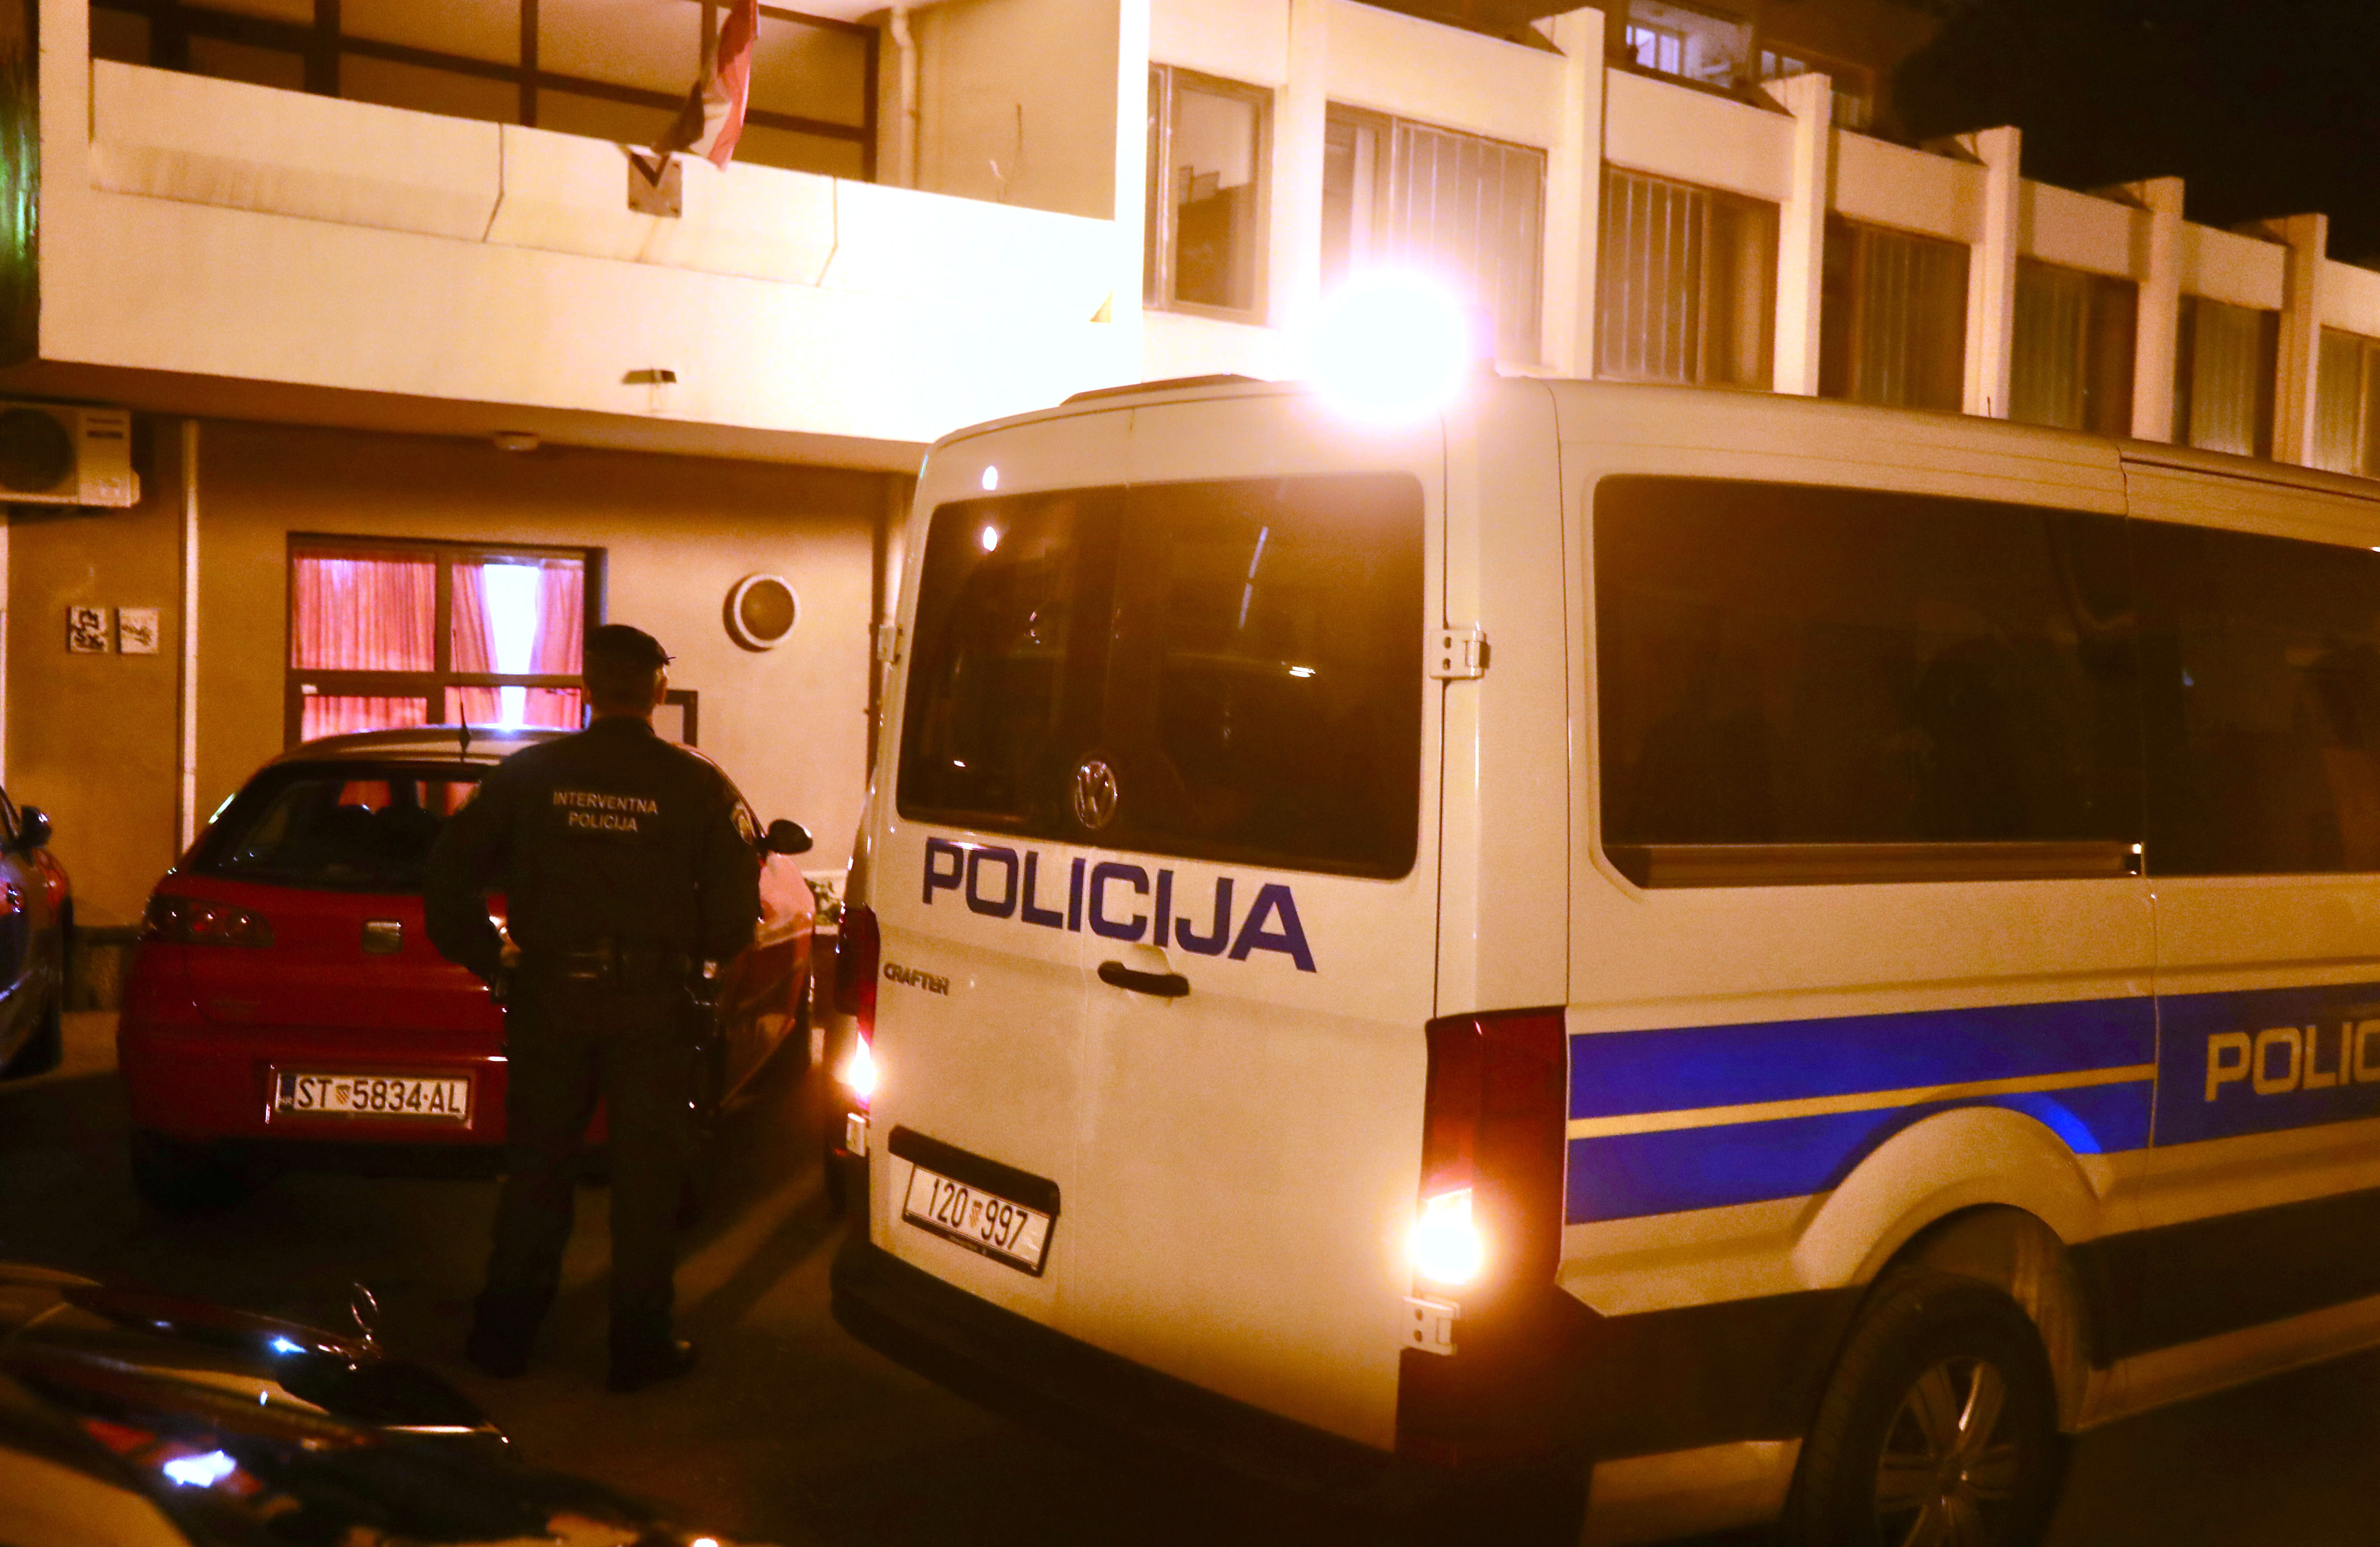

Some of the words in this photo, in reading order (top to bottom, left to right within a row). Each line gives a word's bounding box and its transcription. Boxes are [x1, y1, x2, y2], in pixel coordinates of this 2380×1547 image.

[553, 791, 658, 815] INTERVENTNA
[569, 811, 637, 832] POLICIJA
[922, 837, 1317, 973] POLICIJA
[884, 963, 950, 996] CRAFTER
[298, 1078, 333, 1109] ST
[928, 1178, 968, 1228] 120
[981, 1200, 1028, 1250] 997
